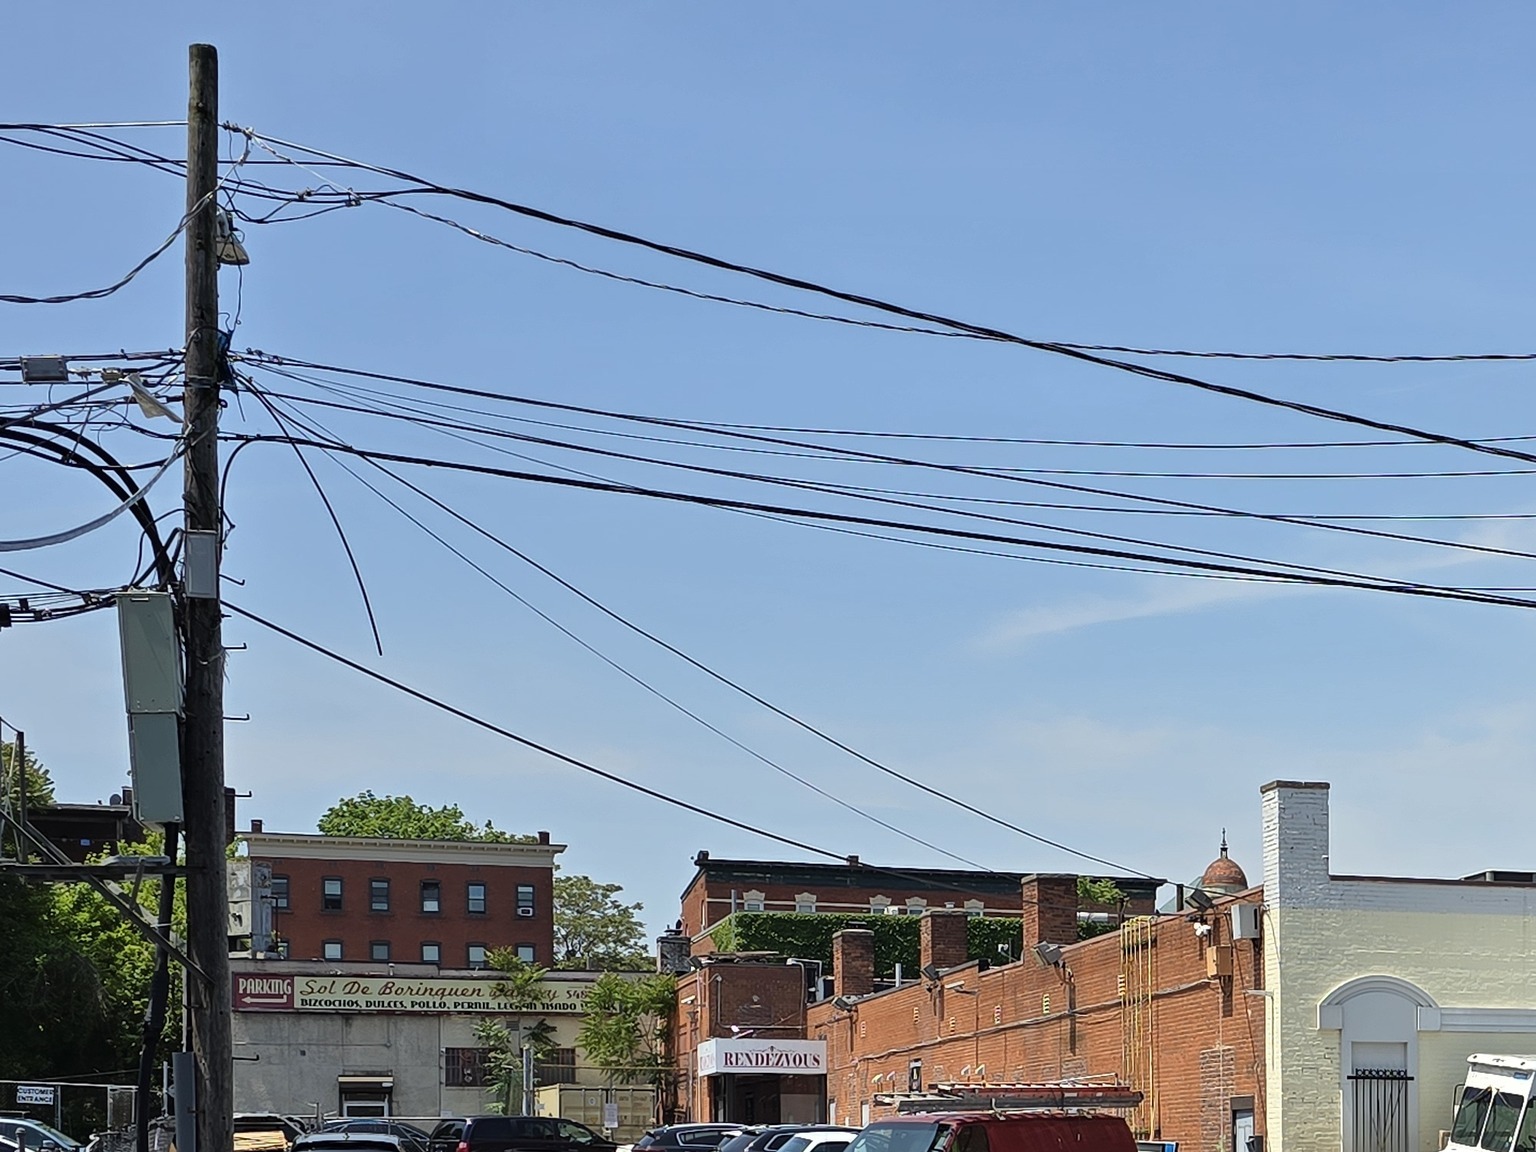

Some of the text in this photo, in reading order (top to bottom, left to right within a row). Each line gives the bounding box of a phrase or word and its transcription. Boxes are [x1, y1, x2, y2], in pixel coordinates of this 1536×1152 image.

[238, 977, 292, 994] PARKING
[300, 979, 337, 996] Sol
[342, 980, 374, 996] De
[377, 981, 484, 1001] Borinquen
[300, 998, 363, 1009] BIZCOCHOS,
[365, 999, 407, 1009] DULCES,
[410, 1000, 450, 1010] POLLO,
[723, 1051, 821, 1068] RENDEZVOUS
[17, 1095, 53, 1103] ENTRANCE
